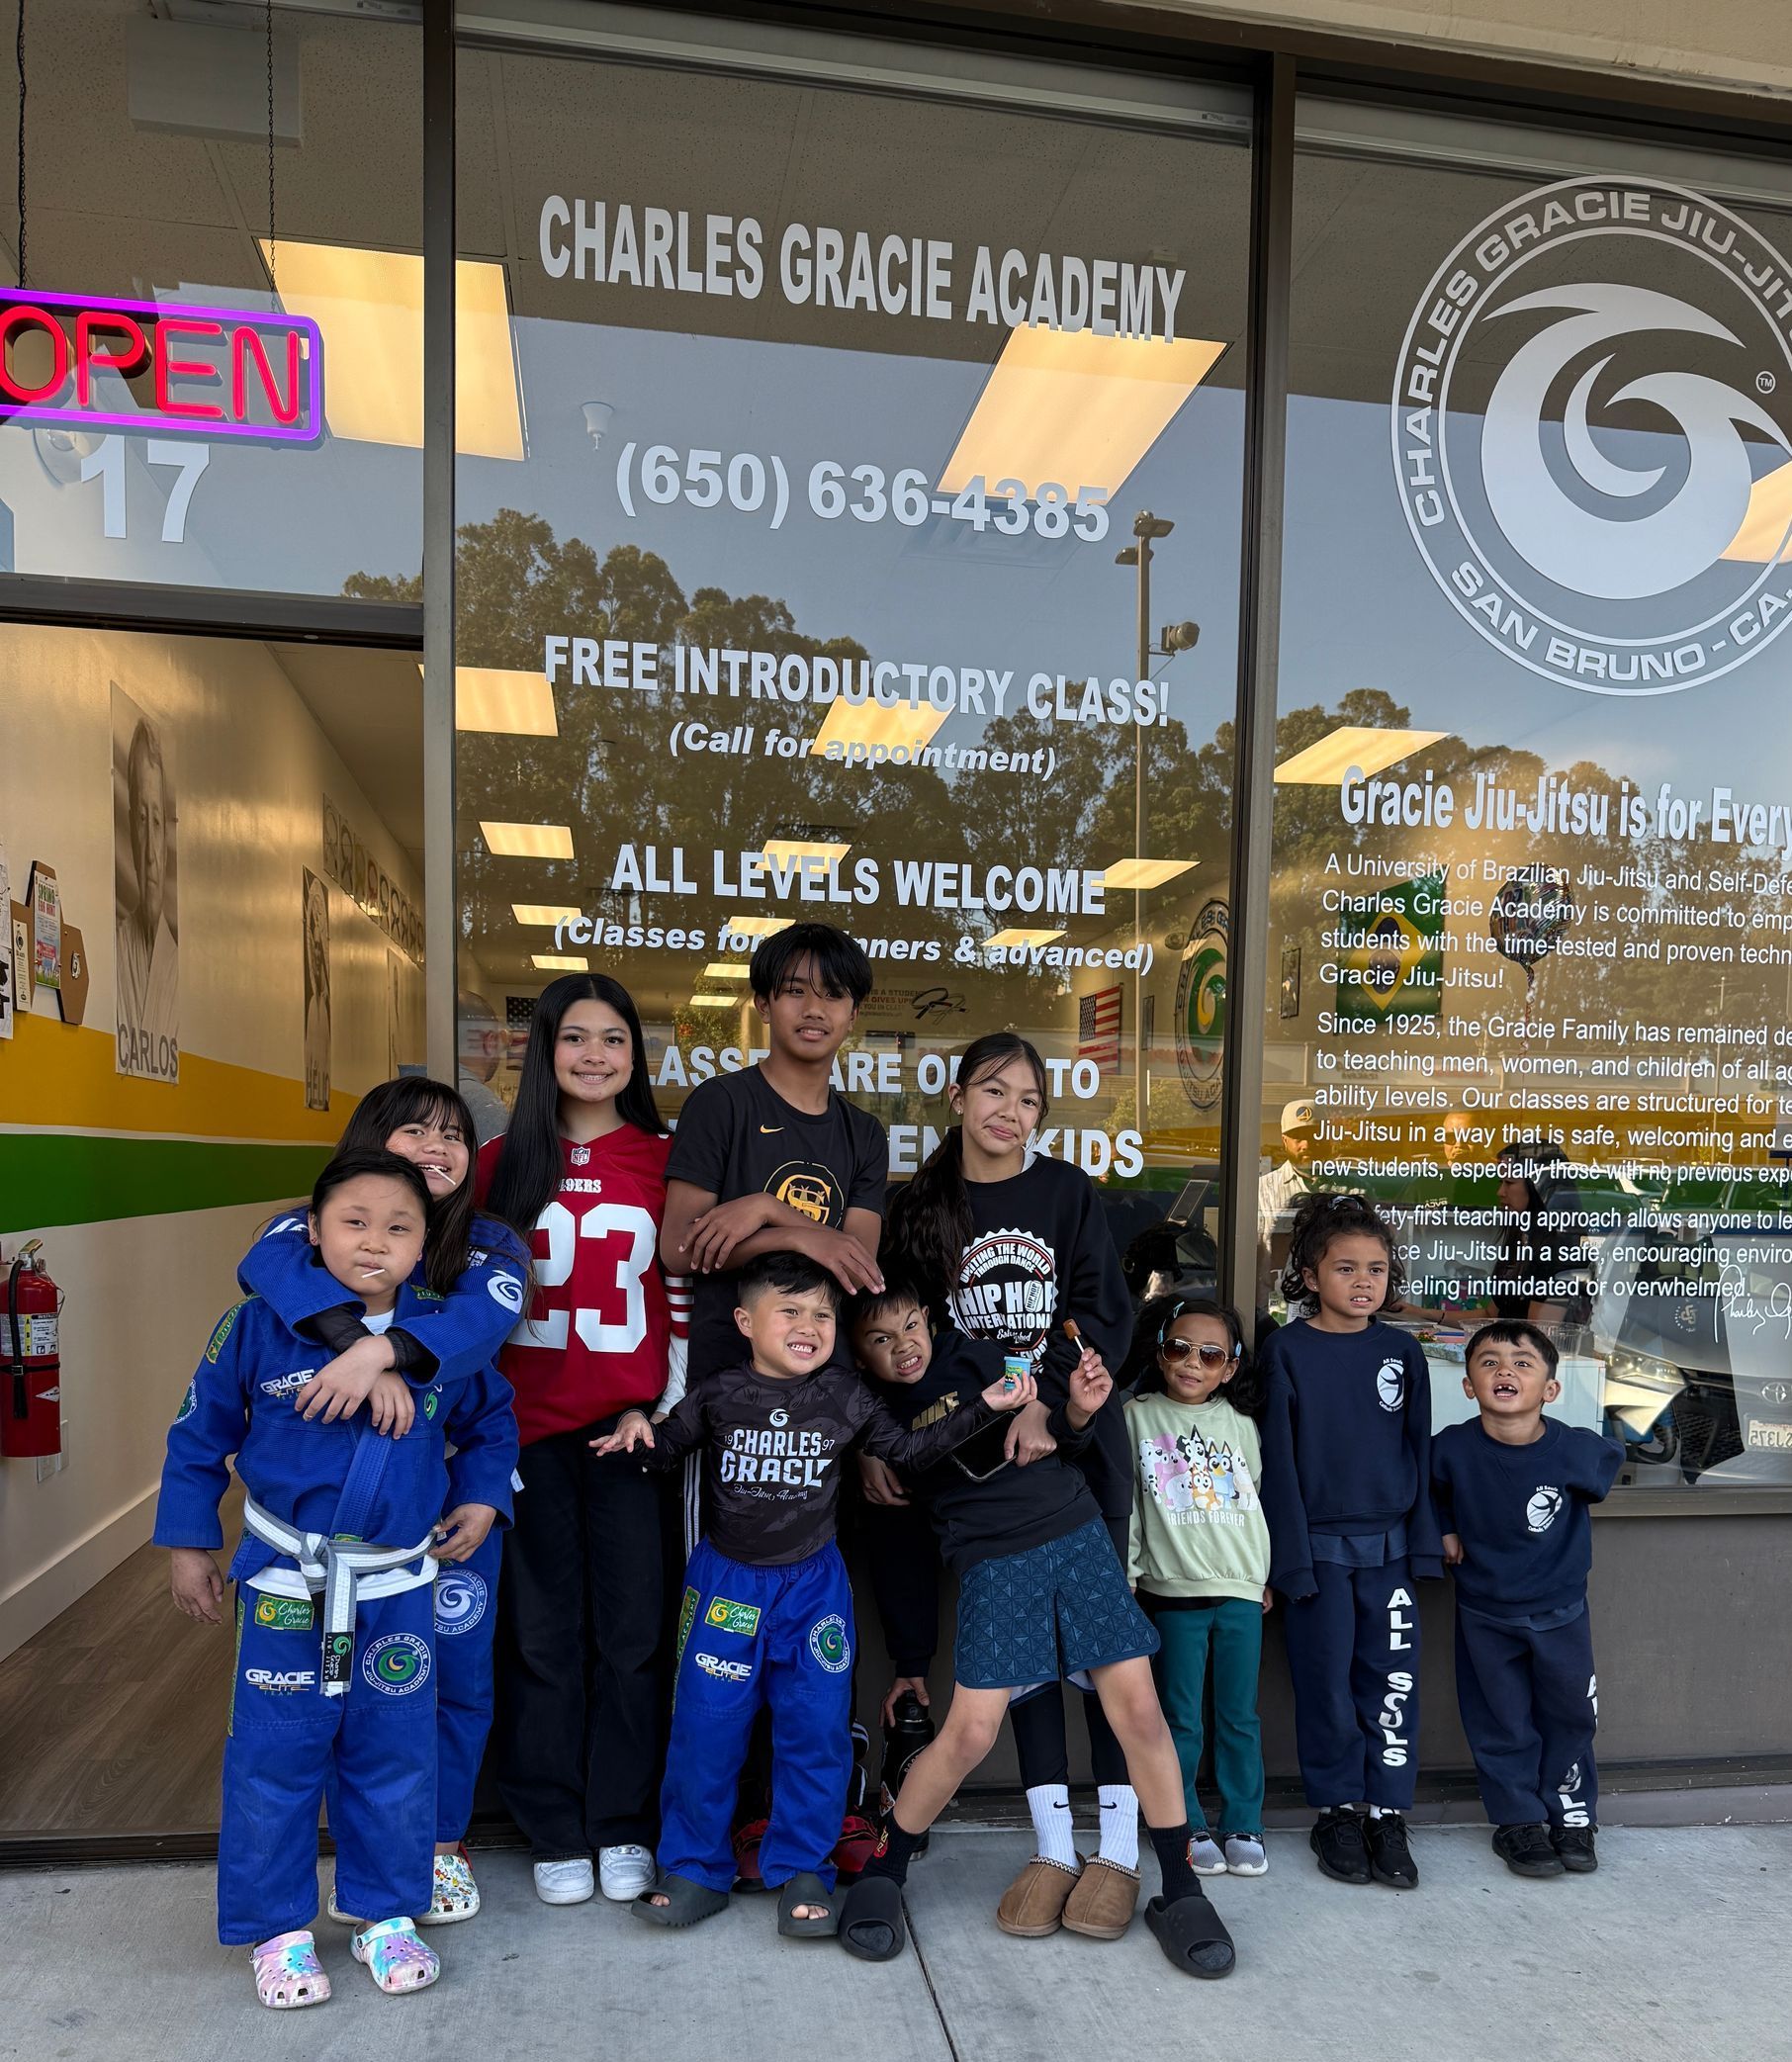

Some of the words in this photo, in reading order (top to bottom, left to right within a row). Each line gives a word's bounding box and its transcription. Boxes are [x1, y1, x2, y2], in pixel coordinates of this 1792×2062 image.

[539, 195, 763, 299] CHARLES
[780, 223, 953, 319] GRACIE
[966, 244, 1187, 344] ACADEMY
[0, 305, 300, 425] OPEN
[1406, 268, 1478, 527] CHARLES
[1475, 191, 1652, 273] GRACIE
[1660, 204, 1792, 339] JIU-JIT
[80, 435, 210, 543] 17
[616, 441, 791, 530] (650)
[807, 460, 1110, 542] 636-4385
[1451, 561, 1540, 651] SAN
[1544, 636, 1707, 681] BRUNO
[545, 635, 660, 690] FREE
[674, 646, 1014, 717] INTRODUCTORY
[1026, 672, 1170, 727] CLASS!
[669, 720, 755, 759] (Call
[764, 728, 816, 758] for
[824, 737, 1056, 781] appointment)
[1340, 764, 1454, 829] Gracie
[1464, 771, 1609, 836] Jiu-Jitsu
[1619, 780, 1647, 839] is
[1657, 782, 1703, 841] for
[1711, 787, 1792, 861] Every
[611, 844, 697, 896] ALL
[714, 852, 880, 905] LEVELS
[893, 859, 1107, 915] WELCOME
[1323, 852, 1341, 874] A
[1347, 852, 1451, 883] University
[1456, 858, 1478, 880] of
[1482, 859, 1570, 884] Brazilian
[1576, 863, 1658, 888] Jiu-Jitsu
[1664, 870, 1702, 891] and
[1322, 890, 1406, 914] Charles
[1413, 892, 1483, 916] Gracie
[1488, 896, 1587, 926] Academy
[1593, 900, 1610, 922] is
[1616, 904, 1721, 927] committed
[1727, 908, 1746, 928] to
[554, 916, 706, 950] (Classes
[717, 925, 766, 953] for
[953, 936, 977, 963] &
[988, 939, 1155, 977] advanced)
[1320, 928, 1410, 950] students
[1416, 931, 1459, 952] with
[1465, 932, 1497, 953] the
[1503, 935, 1617, 958] time-tested
[1623, 939, 1660, 959] and
[1666, 944, 1734, 965] proven
[1319, 962, 1395, 985] Gracie
[1402, 966, 1504, 989] Jiu-Jitsu!
[1317, 1012, 1377, 1035] Since
[1385, 1014, 1442, 1039] 1925,
[1448, 1016, 1480, 1037] the
[1487, 1017, 1556, 1038] Gracie
[1563, 1019, 1630, 1046] Family
[1635, 1021, 1671, 1042] has
[1677, 1024, 1768, 1046] remained
[117, 1023, 179, 1078] CARLOS
[1316, 1049, 1337, 1069] to
[1343, 1049, 1435, 1077] teaching
[1442, 1055, 1494, 1076] men,
[1501, 1056, 1583, 1078] women,
[1590, 1055, 1630, 1076] and
[1636, 1056, 1716, 1078] children
[1722, 1058, 1743, 1079] of
[1747, 1059, 1769, 1080] all
[1045, 1058, 1100, 1099] TO
[1314, 1084, 1379, 1112] ability
[1386, 1086, 1454, 1108] levels.
[1462, 1087, 1503, 1109] Our
[1509, 1088, 1589, 1111] classes
[1595, 1094, 1631, 1111] are
[1637, 1092, 1740, 1114] structured
[1746, 1094, 1774, 1115] for
[1313, 1120, 1401, 1142] Jiu-Jitsu
[1408, 1121, 1426, 1142] in
[1433, 1126, 1446, 1143] a
[1454, 1128, 1496, 1148] way
[1501, 1123, 1543, 1144] that
[1548, 1124, 1565, 1144] is
[1570, 1123, 1621, 1149] safe,
[1627, 1125, 1734, 1153] welcoming
[1740, 1128, 1777, 1148] and
[1025, 1129, 1144, 1178] KIDS
[1311, 1160, 1351, 1177] new
[1357, 1156, 1444, 1181] students,
[1451, 1158, 1545, 1183] especially
[1550, 1159, 1601, 1180] those
[1606, 1159, 1644, 1181] with
[1649, 1164, 1672, 1182] no
[1677, 1163, 1753, 1186] previous
[1758, 1166, 1792, 1188] exp
[1454, 1206, 1532, 1231] teaching
[1537, 1207, 1621, 1231] approach
[1627, 1208, 1682, 1228] allows
[1687, 1211, 1756, 1233] anyone
[1756, 1210, 1773, 1229] to
[959, 1247, 996, 1284] UNITING
[995, 1243, 1017, 1255] THE
[1017, 1244, 1051, 1276] WORLD
[973, 1254, 1010, 1279] THROUGH
[1010, 1255, 1036, 1274] DANCE
[1427, 1240, 1509, 1261] Jiu-Jitsu
[1516, 1240, 1533, 1261] in
[1540, 1244, 1552, 1261] a
[1558, 1243, 1605, 1266] safe,
[1612, 1243, 1731, 1268] encouraging
[507, 1202, 658, 1353] 23
[1468, 1275, 1579, 1296] intimidated
[1585, 1280, 1607, 1297] or
[1613, 1277, 1751, 1298] overwhelmed.
[957, 1284, 1002, 1316] HIP
[260, 1369, 315, 1393] GRACIE
[732, 1428, 822, 1457] CHARLES
[821, 1439, 835, 1451] 97
[1209, 1510, 1245, 1527] FOREVER
[278, 1602, 311, 1616] Charles
[283, 1615, 310, 1625] Gracie
[451, 1601, 484, 1633] ACADEMY
[729, 1606, 757, 1621] Charles
[1387, 1587, 1413, 1651] ALL
[365, 1636, 402, 1665] CHARLES
[403, 1636, 427, 1659] GRACIE
[695, 1653, 753, 1677] GRACIE
[245, 1668, 315, 1685] GRACIE
[366, 1669, 397, 1693] JIU-JITSU
[398, 1662, 428, 1694] ACADEMY
